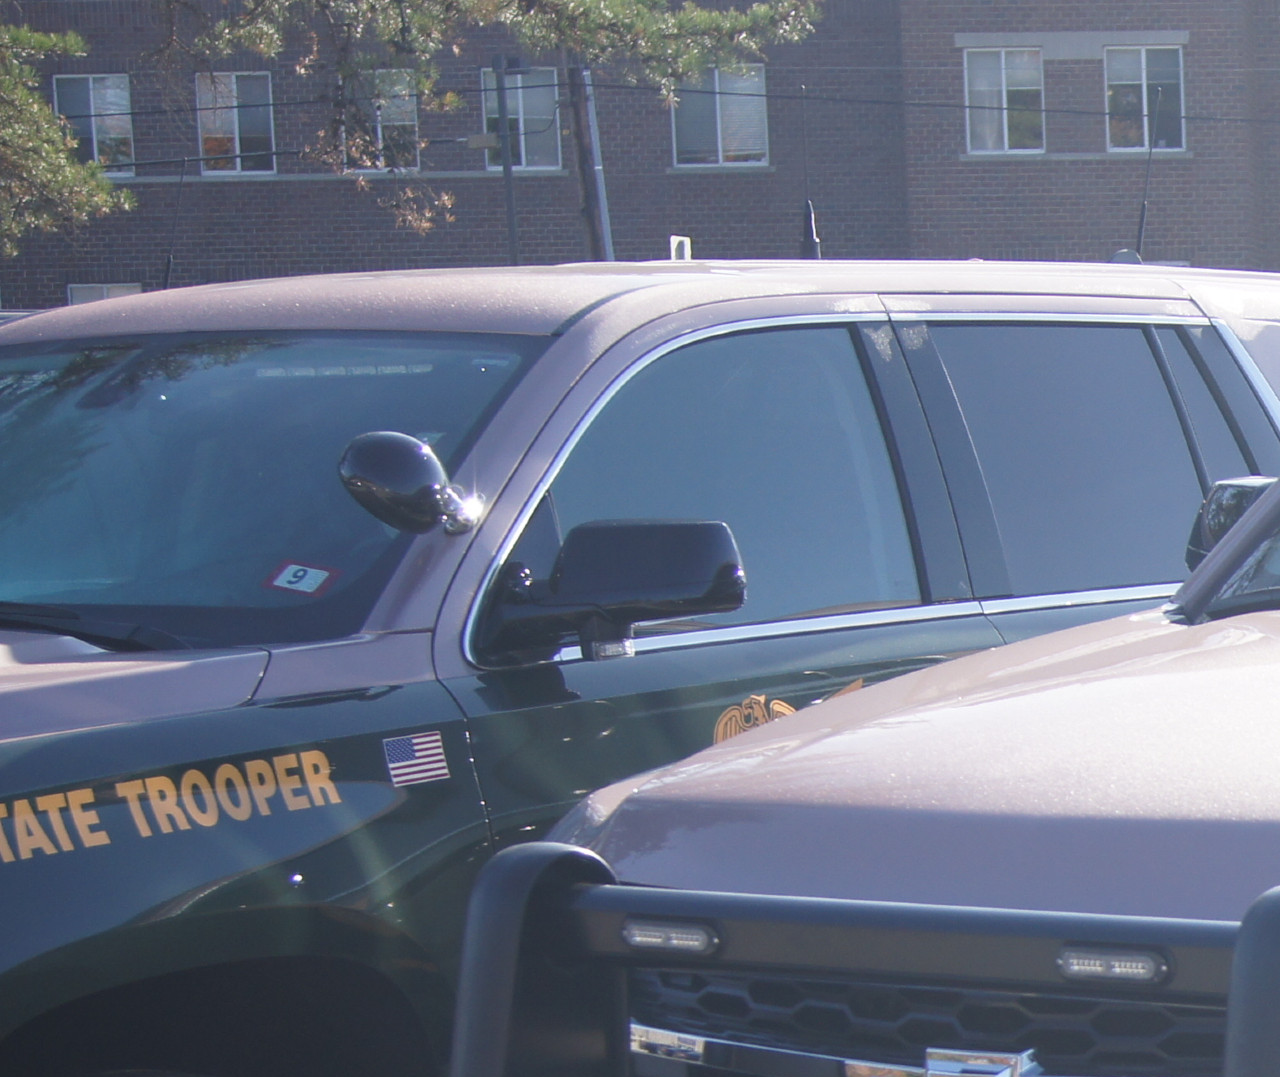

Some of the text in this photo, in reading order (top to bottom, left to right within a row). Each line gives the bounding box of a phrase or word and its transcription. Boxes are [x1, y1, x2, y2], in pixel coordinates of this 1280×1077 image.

[285, 568, 309, 585] 9
[0, 750, 342, 863] TATE TROOPER
